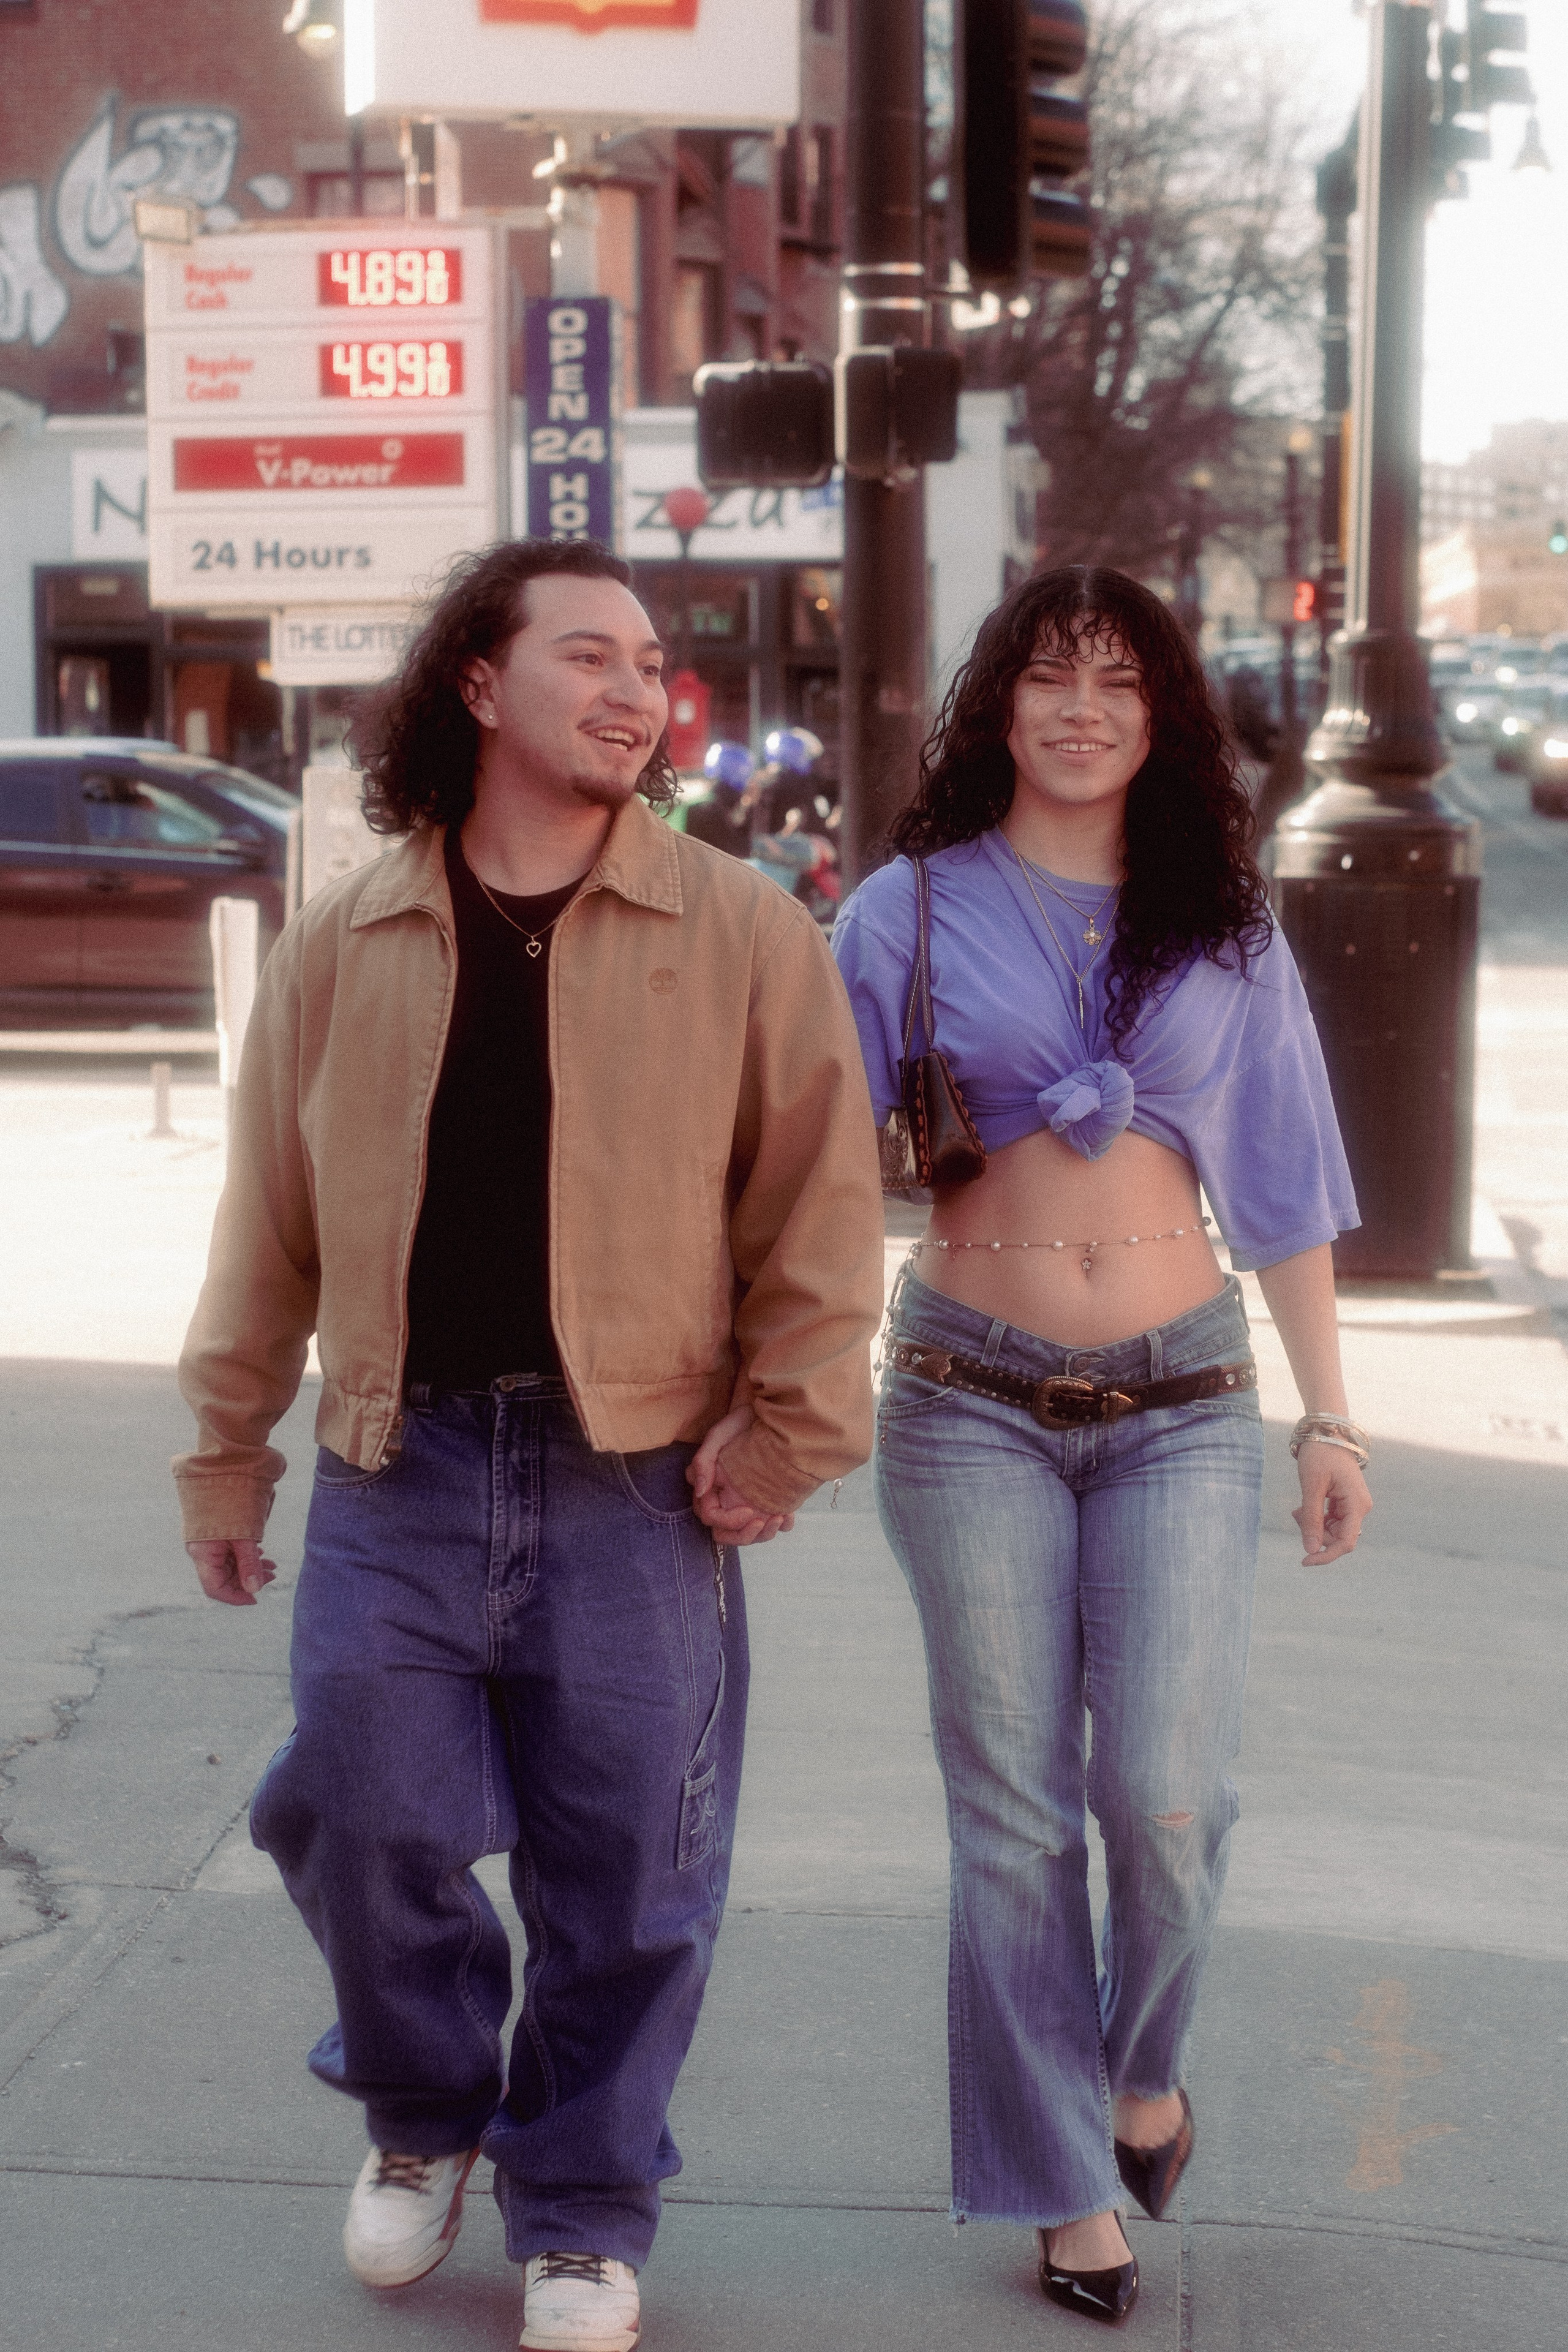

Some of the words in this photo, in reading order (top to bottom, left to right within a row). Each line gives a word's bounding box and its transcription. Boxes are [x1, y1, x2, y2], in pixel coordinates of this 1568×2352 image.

[547, 306, 589, 421] OPEN
[530, 427, 608, 464] 24
[255, 457, 397, 486] V-Power
[191, 540, 237, 571] 24
[255, 539, 372, 570] Hours
[288, 624, 329, 650] THE
